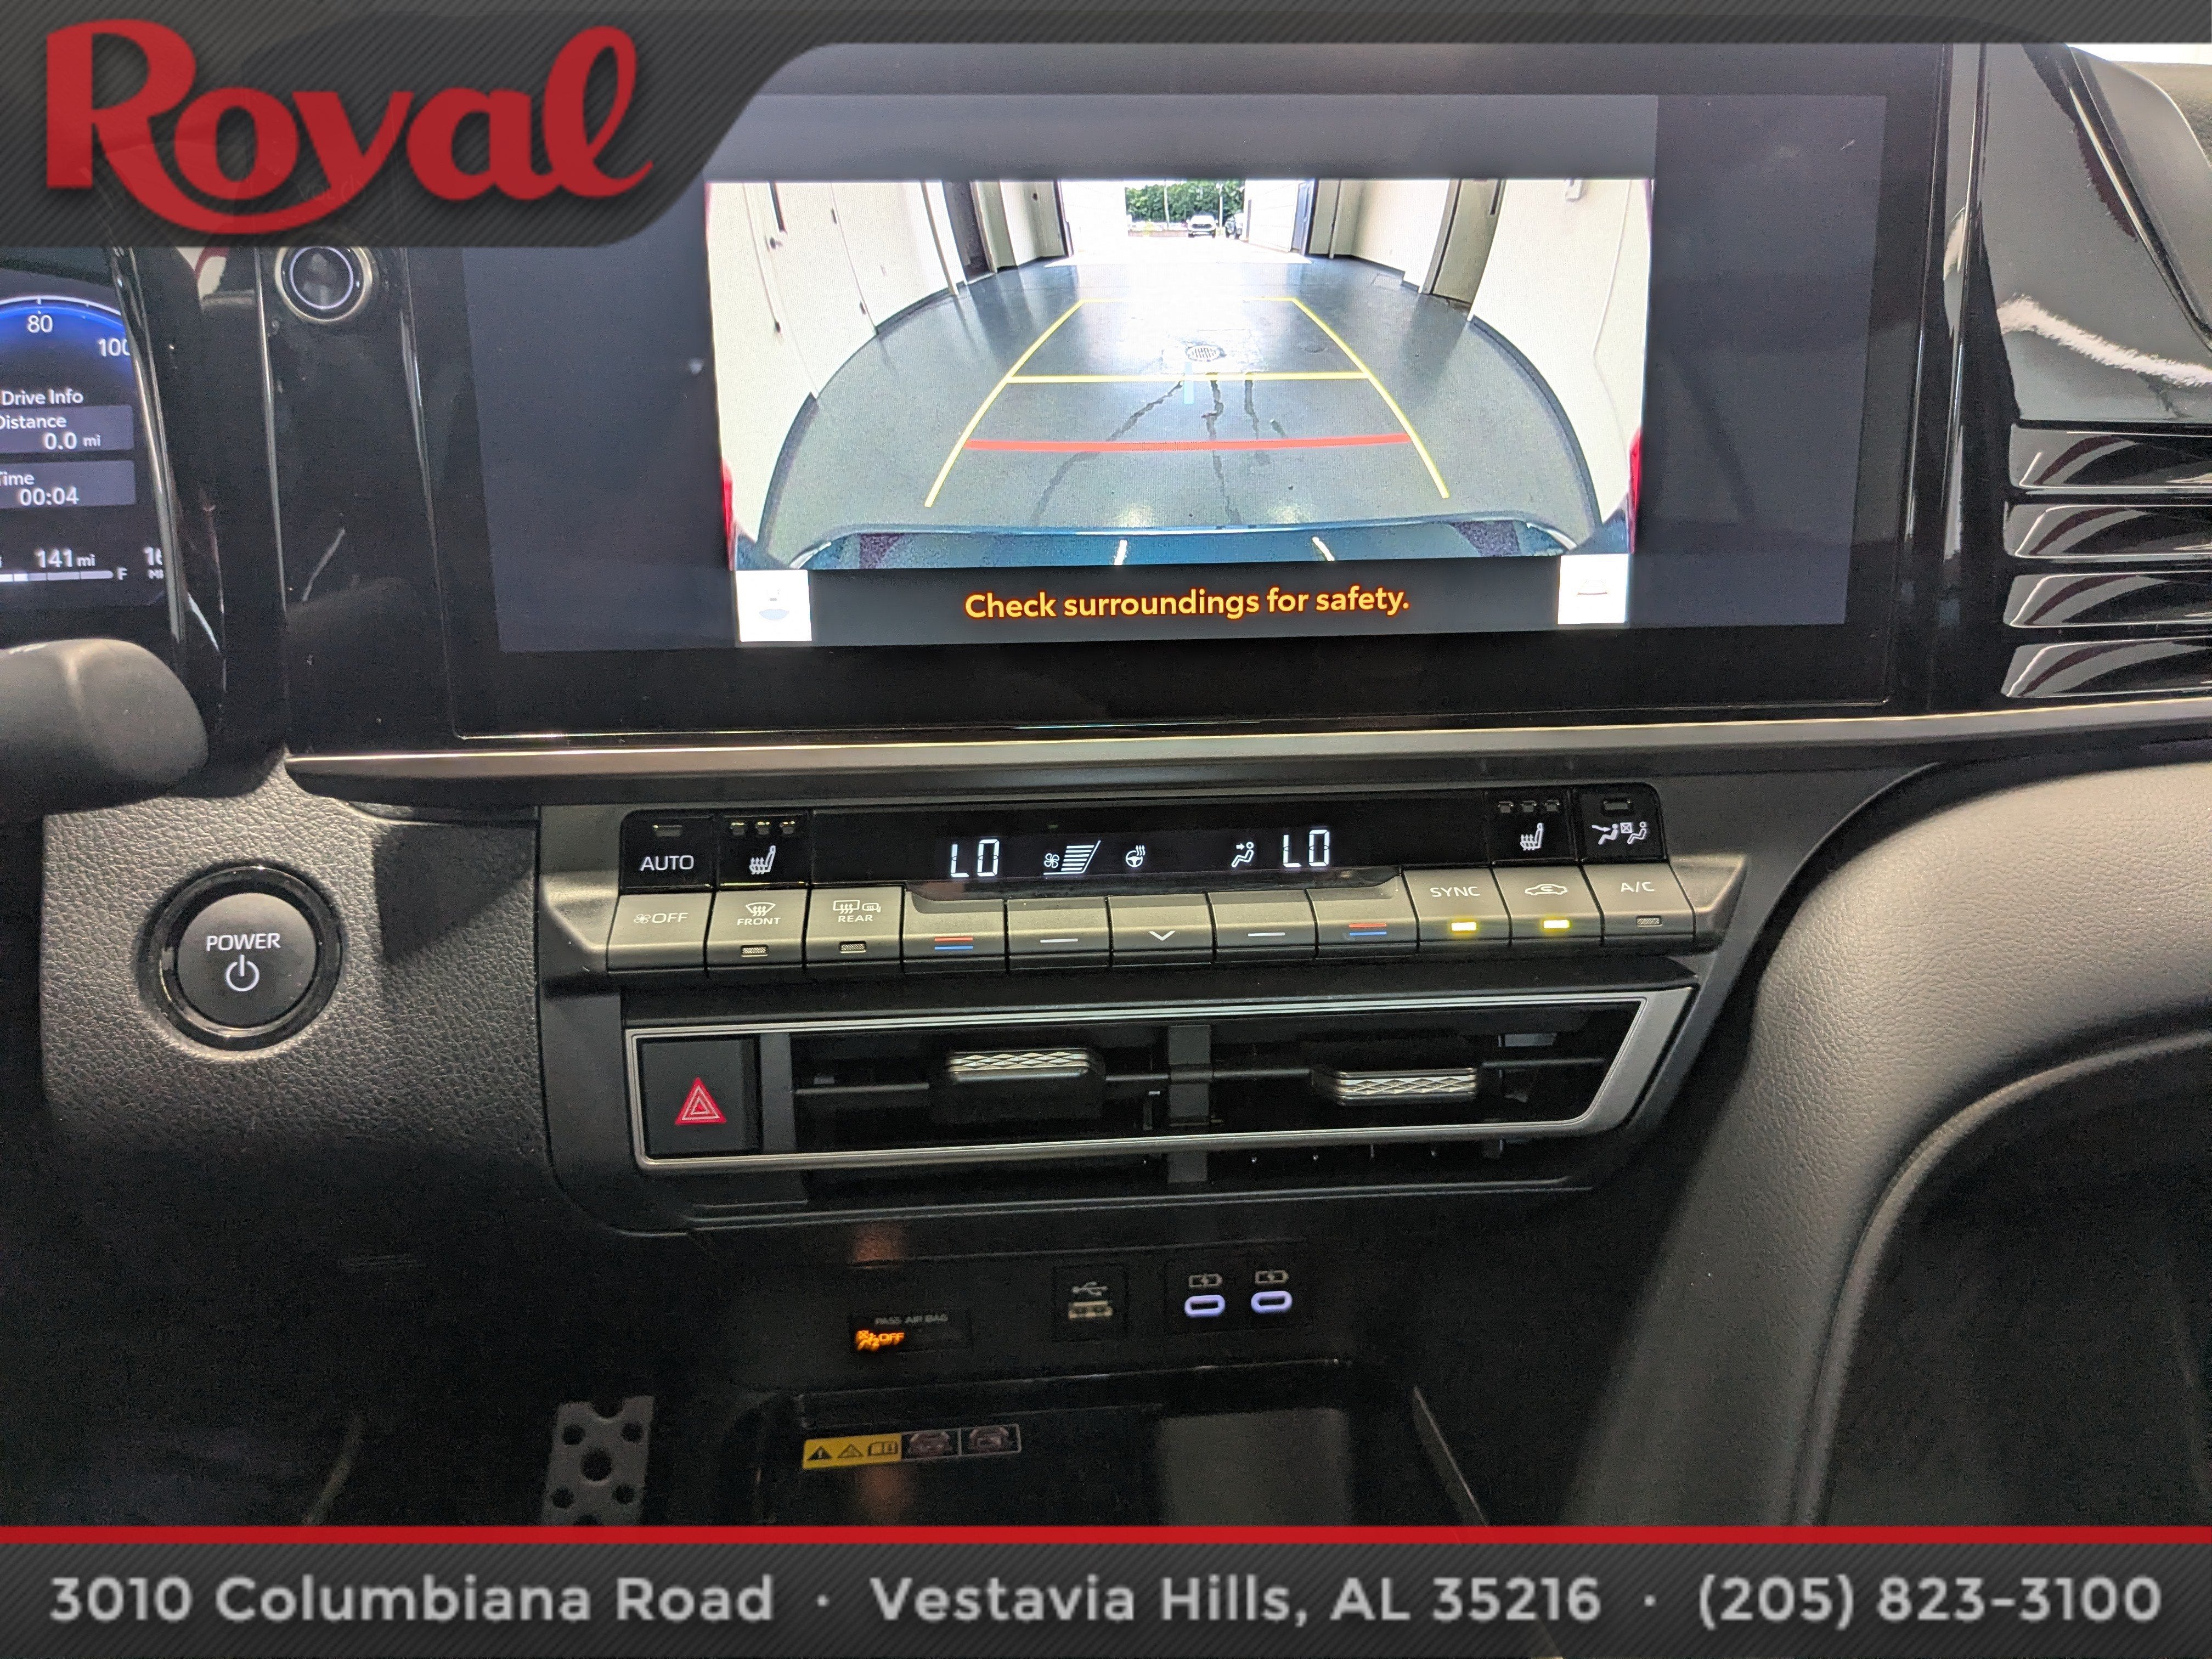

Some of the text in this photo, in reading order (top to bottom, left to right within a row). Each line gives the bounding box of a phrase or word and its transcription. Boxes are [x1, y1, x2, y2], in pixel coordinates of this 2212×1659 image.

[27, 314, 53, 334] 80
[2, 388, 84, 406] Drive Info
[43, 432, 101, 450] 0.0 mi
[20, 487, 80, 506] 00:04
[34, 548, 95, 568] 141 mi
[116, 567, 128, 580] F
[964, 585, 1410, 619] Check surroundings for safety.
[640, 855, 695, 871] AUTO
[1430, 885, 1481, 898] SYNC
[1620, 881, 1656, 893] A/C
[651, 912, 689, 924] OFF
[736, 917, 782, 926] FRONT
[837, 915, 874, 923] REAR
[205, 932, 281, 952] POWER
[878, 1332, 905, 1346] OFF
